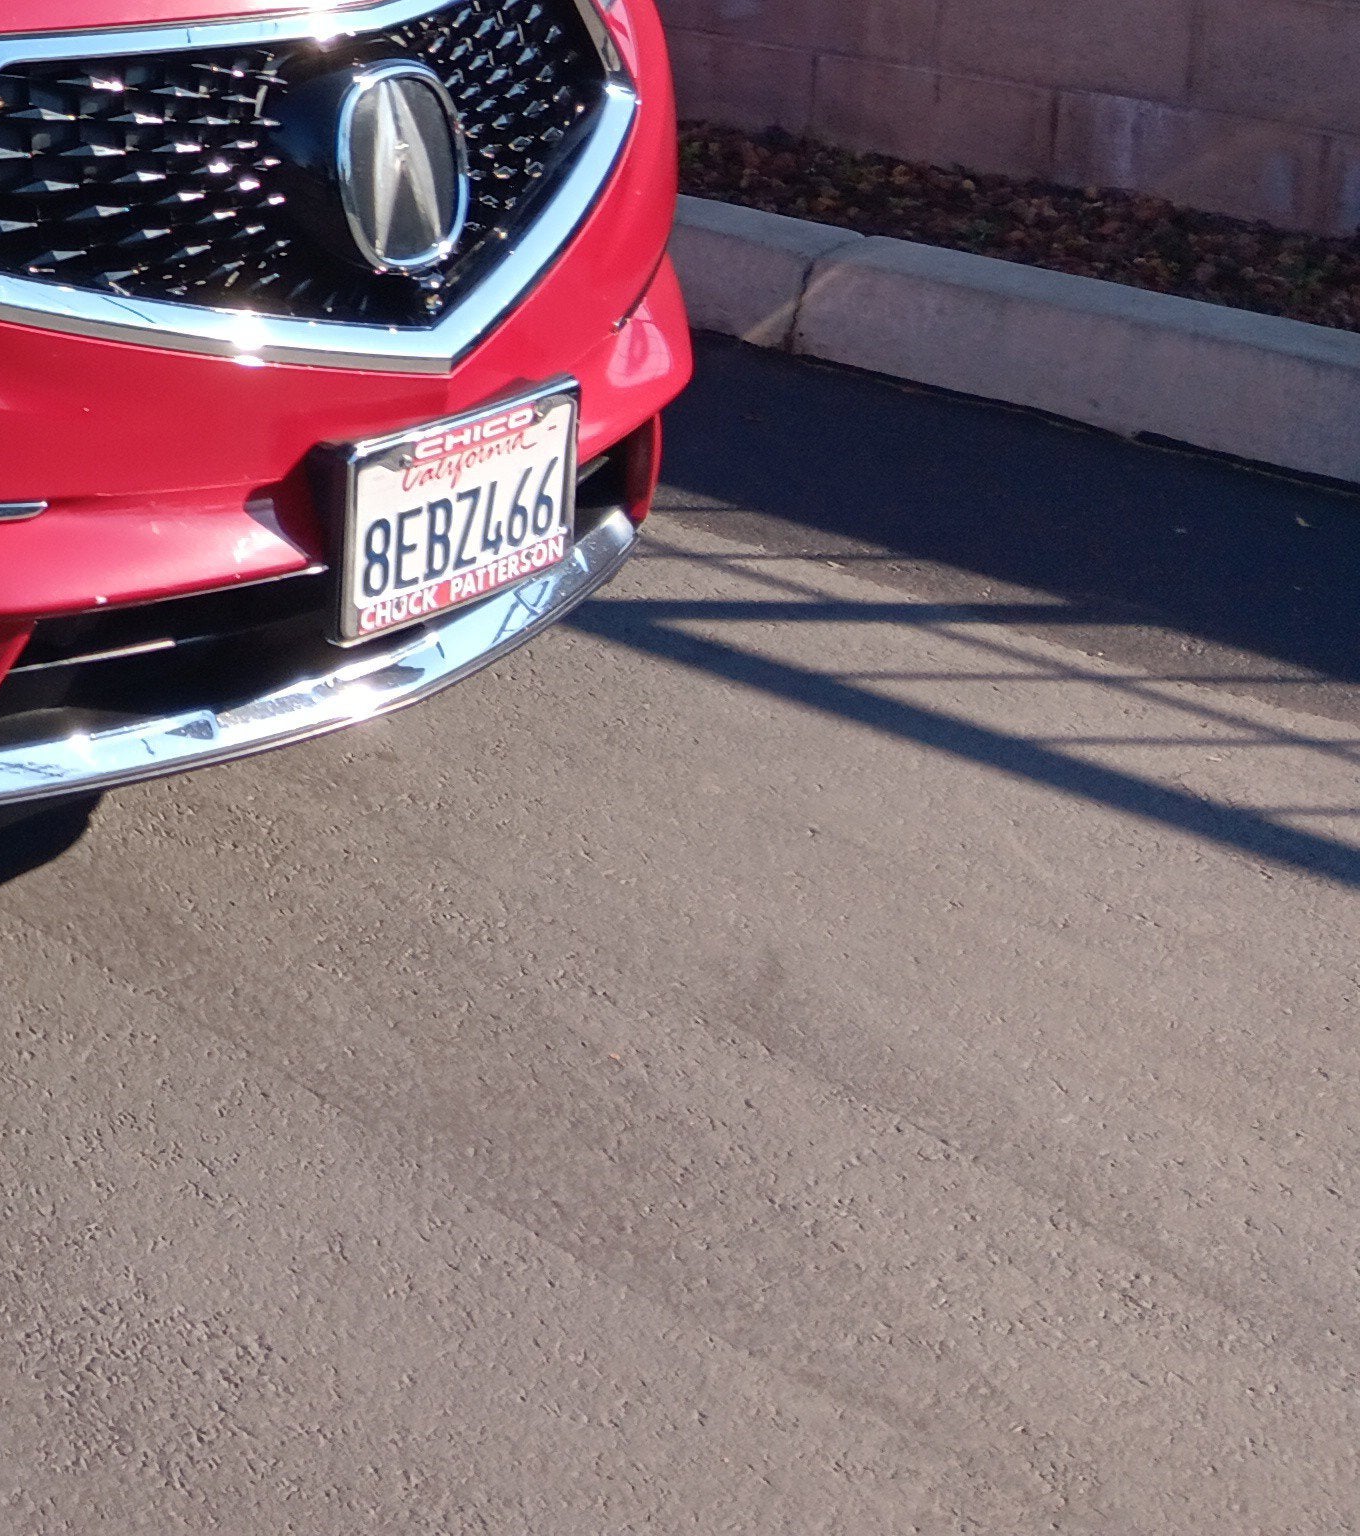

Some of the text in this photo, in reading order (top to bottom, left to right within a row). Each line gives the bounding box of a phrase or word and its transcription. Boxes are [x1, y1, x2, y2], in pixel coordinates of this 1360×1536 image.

[402, 431, 538, 491] California
[415, 408, 534, 459] CHICO
[362, 456, 559, 597] 8EBZ466
[361, 535, 564, 631] CHUCK PATTERSON
